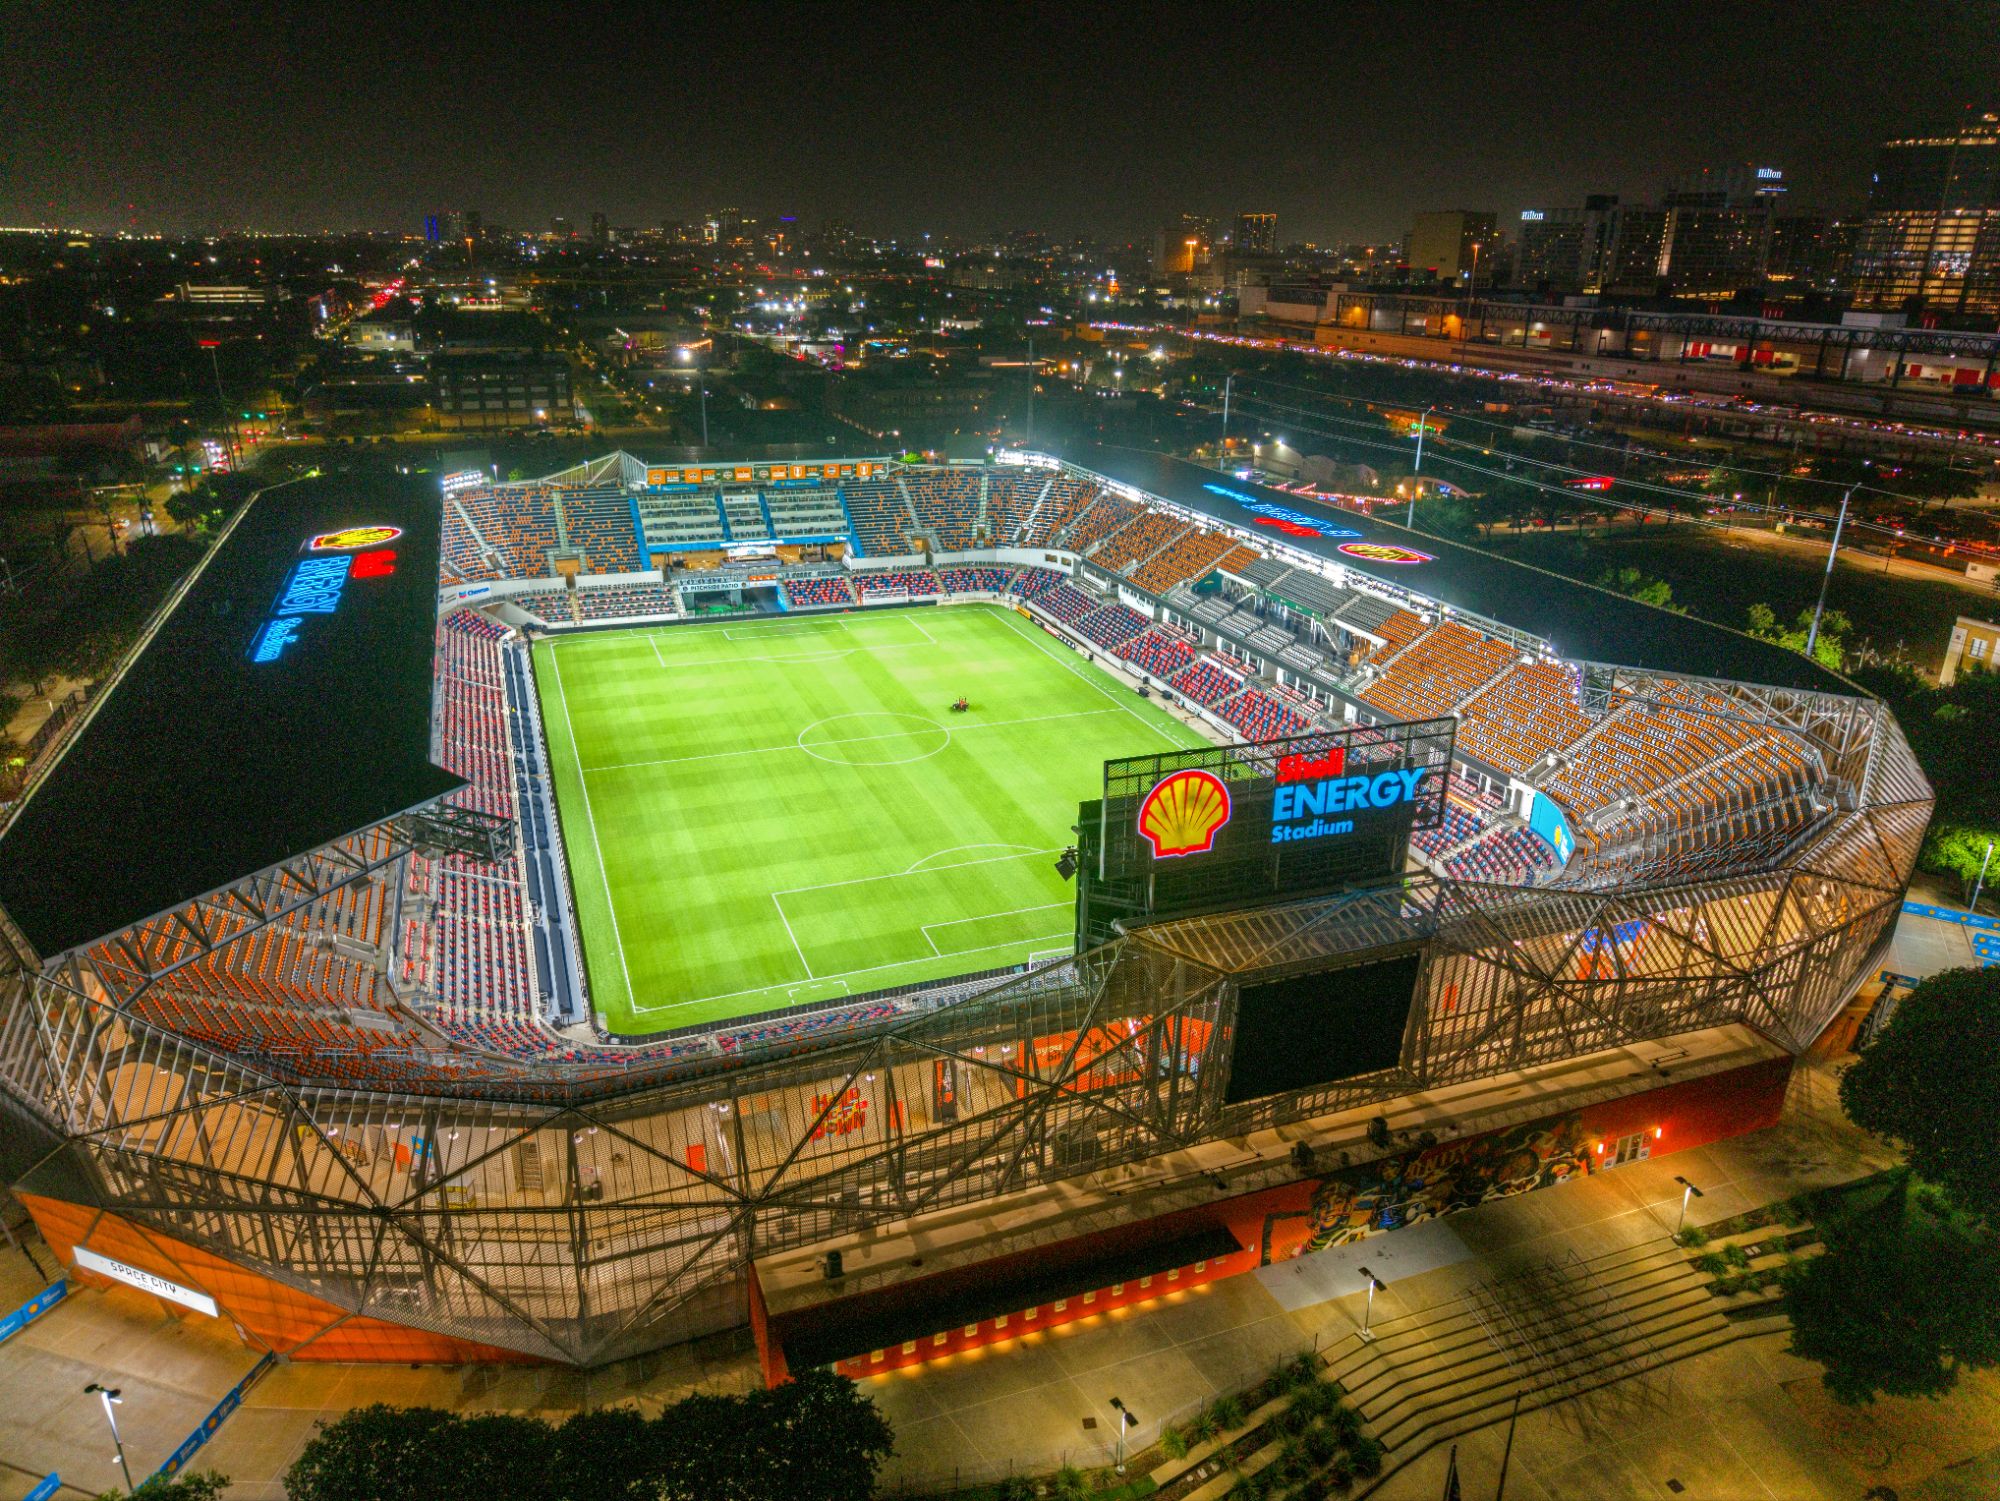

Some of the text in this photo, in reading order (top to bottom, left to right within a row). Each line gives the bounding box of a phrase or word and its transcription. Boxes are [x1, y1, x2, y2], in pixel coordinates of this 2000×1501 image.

[1757, 168, 1782, 179] Hilton
[1276, 747, 1345, 783] Shell
[1272, 767, 1425, 822] ENERGY
[1271, 818, 1353, 844] Stadium
[110, 1262, 147, 1283] SPACE
[151, 1277, 176, 1293] CITY
